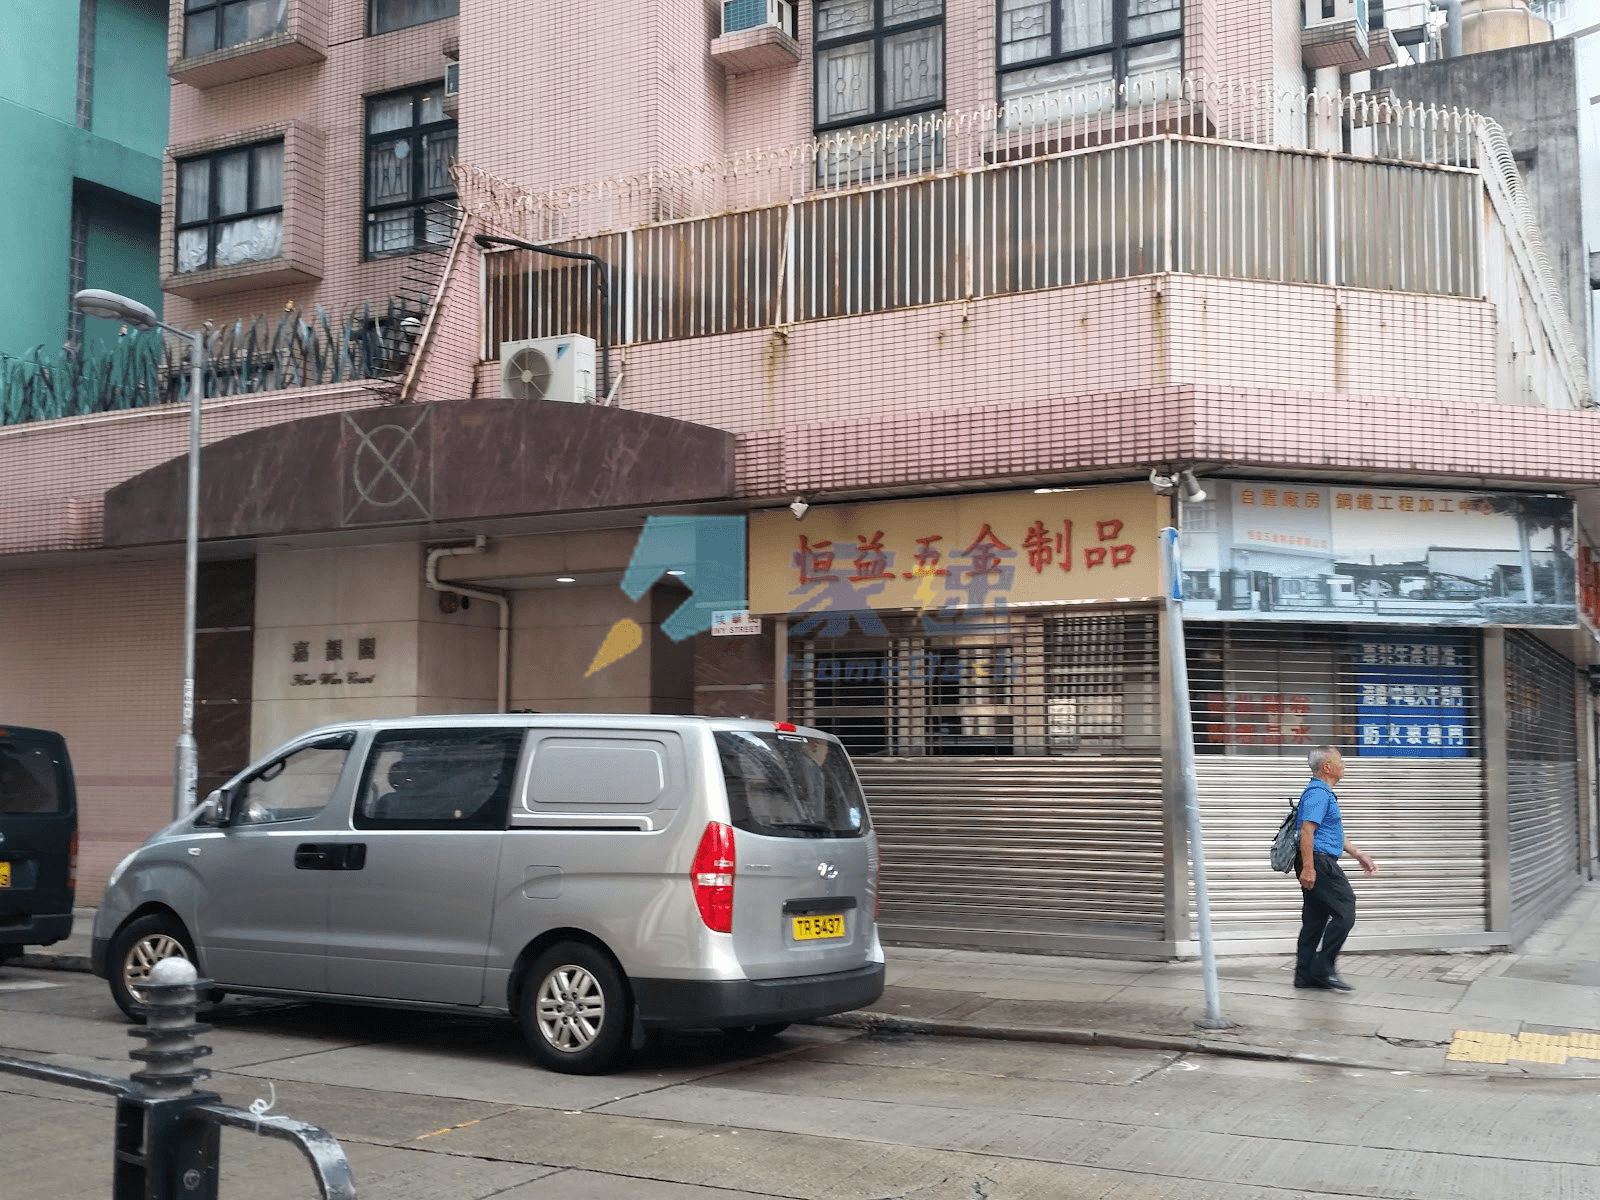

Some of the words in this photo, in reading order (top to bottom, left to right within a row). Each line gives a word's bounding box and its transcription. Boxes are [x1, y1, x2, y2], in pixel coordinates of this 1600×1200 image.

[793, 519, 1135, 584] 恒益五金制品
[715, 626, 726, 634] IVY
[729, 625, 760, 633] STREET
[346, 671, 376, 685] Court
[1363, 722, 1464, 745] 防火玻璃門
[797, 919, 812, 936] TR
[814, 917, 840, 935] 5437
